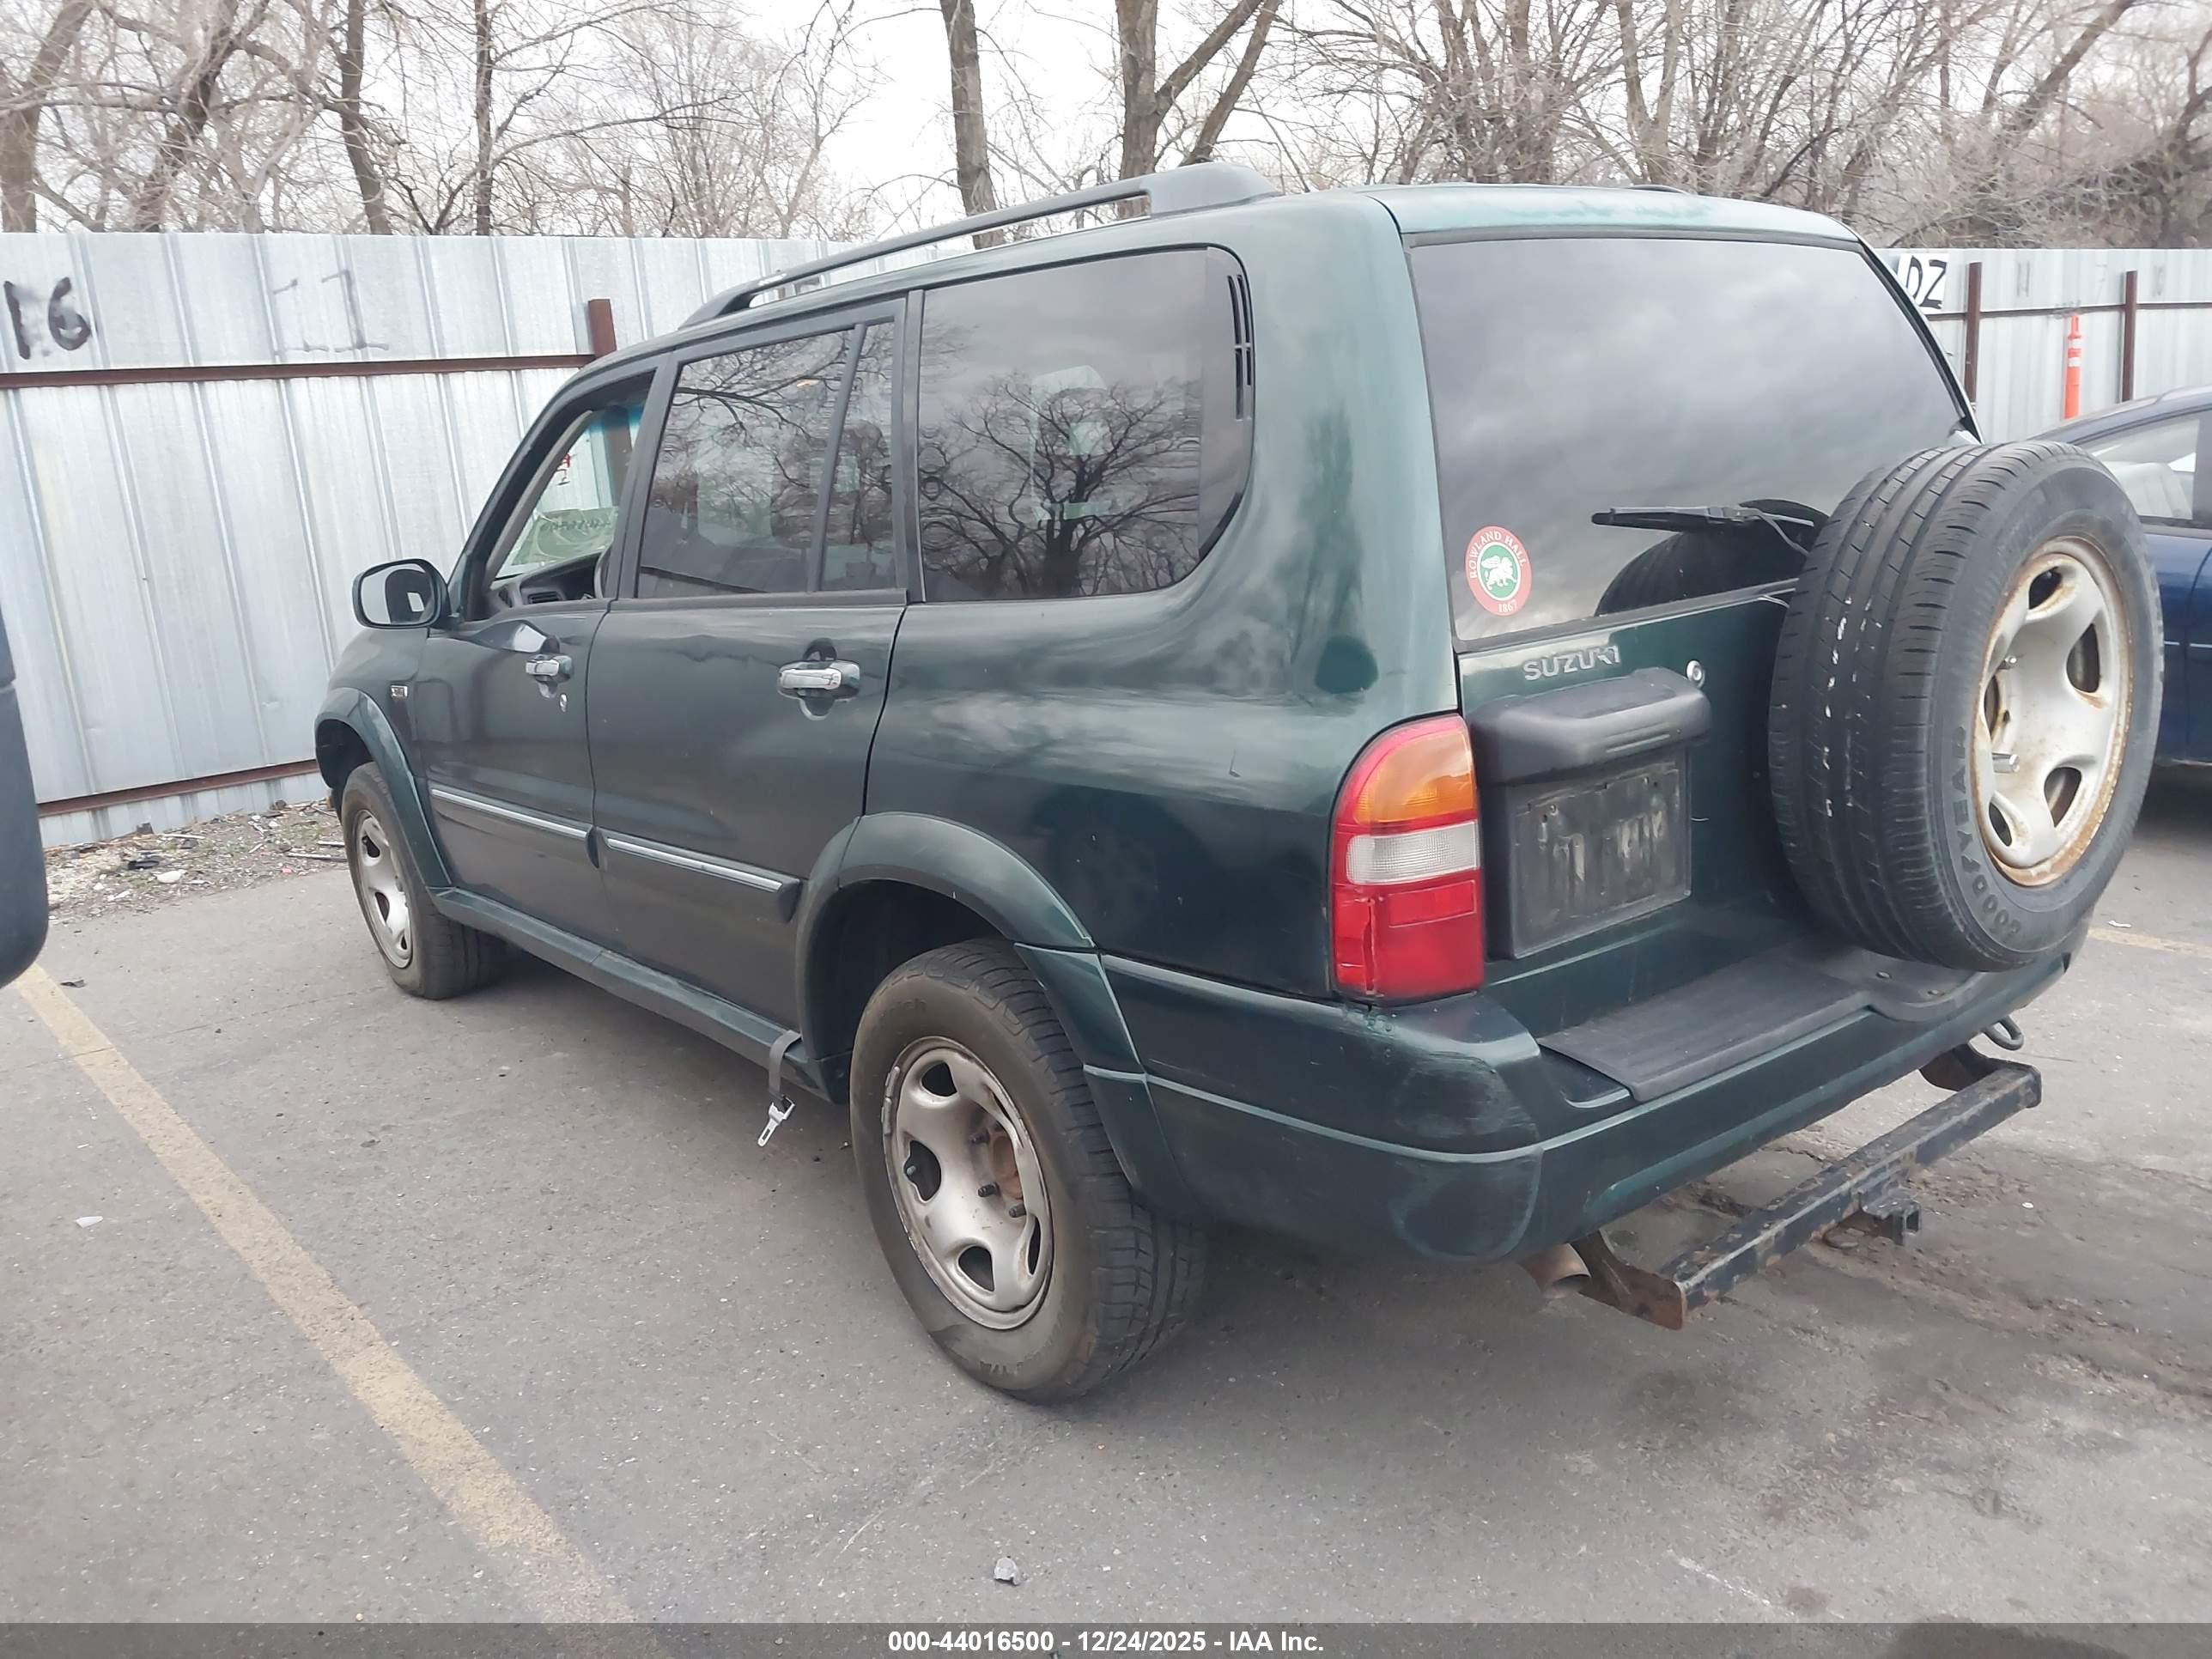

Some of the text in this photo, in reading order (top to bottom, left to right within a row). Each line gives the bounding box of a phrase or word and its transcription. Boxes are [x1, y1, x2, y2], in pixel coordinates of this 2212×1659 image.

[3, 276, 92, 360] 16
[1468, 531, 1527, 579] ROWLAND HALL
[1498, 599, 1517, 613] 1867
[1523, 645, 1620, 681] SUZUKI
